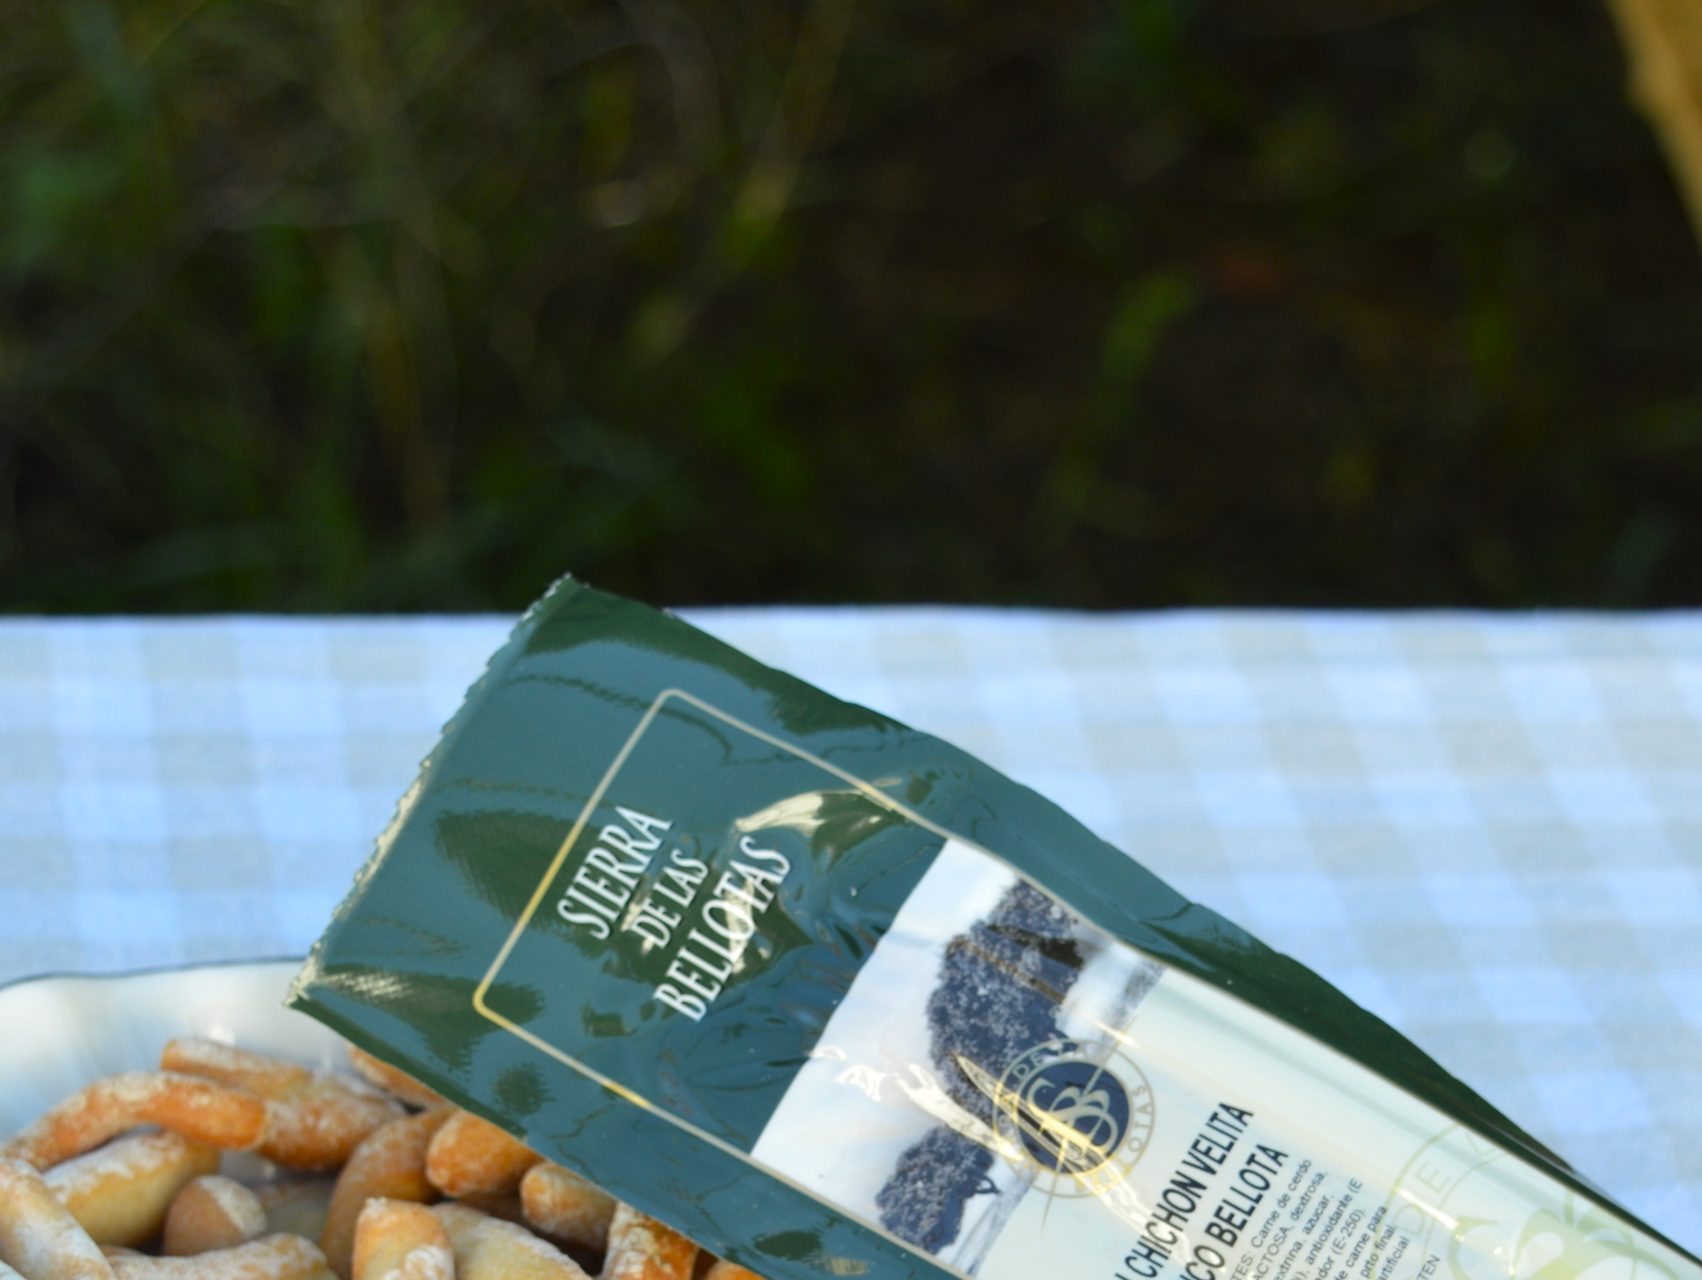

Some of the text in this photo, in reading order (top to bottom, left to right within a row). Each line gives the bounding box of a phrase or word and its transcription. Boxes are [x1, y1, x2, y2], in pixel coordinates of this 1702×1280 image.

[557, 806, 672, 939] SIERRA
[629, 848, 710, 949] DE LAS
[653, 835, 792, 1022] BELLOTAS
[1181, 1103, 1253, 1174] VELITA
[1204, 1144, 1287, 1247] BELLOTA
[1250, 1209, 1280, 1249] Carne
[1286, 1158, 1311, 1191] cerdo
[1303, 1192, 1352, 1265] antioxidante
[1344, 1232, 1370, 1268] carne
[1366, 1205, 1388, 1233] para
